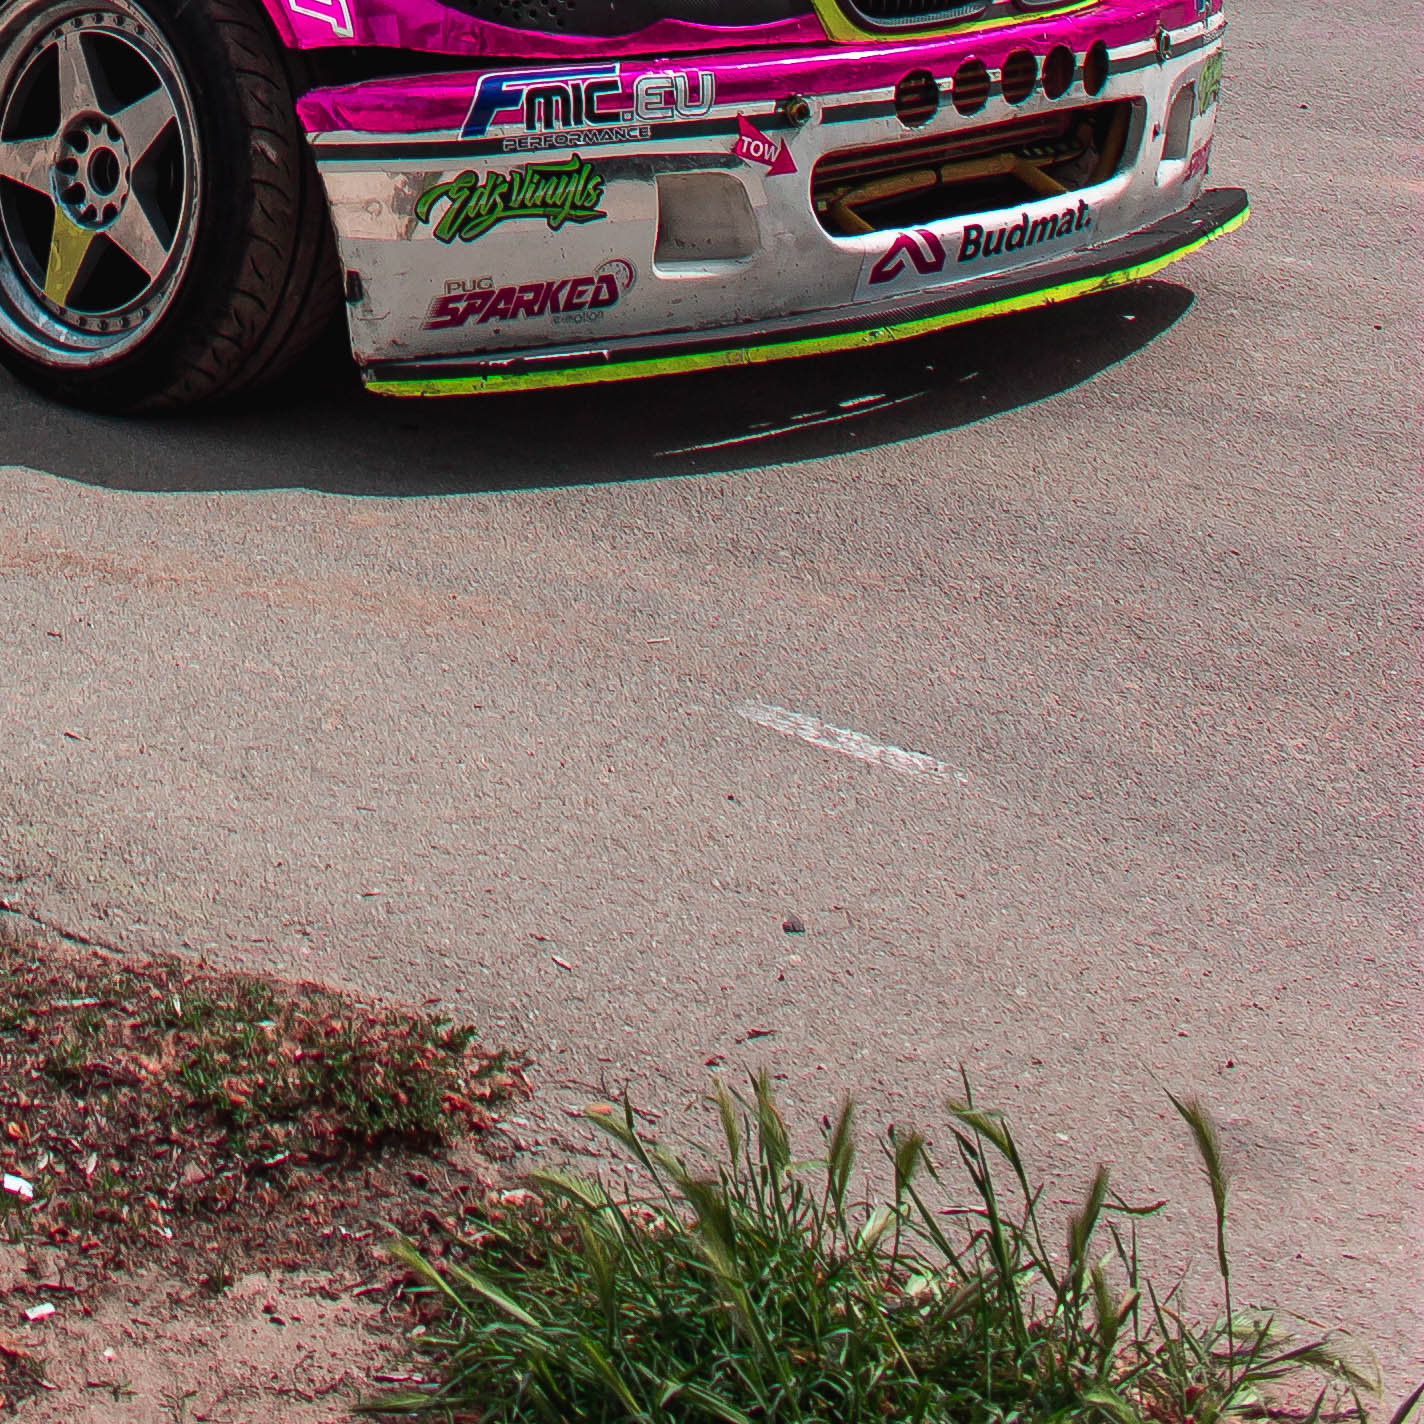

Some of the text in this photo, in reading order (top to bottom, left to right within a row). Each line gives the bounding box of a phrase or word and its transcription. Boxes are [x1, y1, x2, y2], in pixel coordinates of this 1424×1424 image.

[502, 125, 652, 151] PERFORMANCE
[739, 134, 780, 162] TOW
[444, 276, 494, 294] PUG
[422, 272, 619, 332] SPARKED
